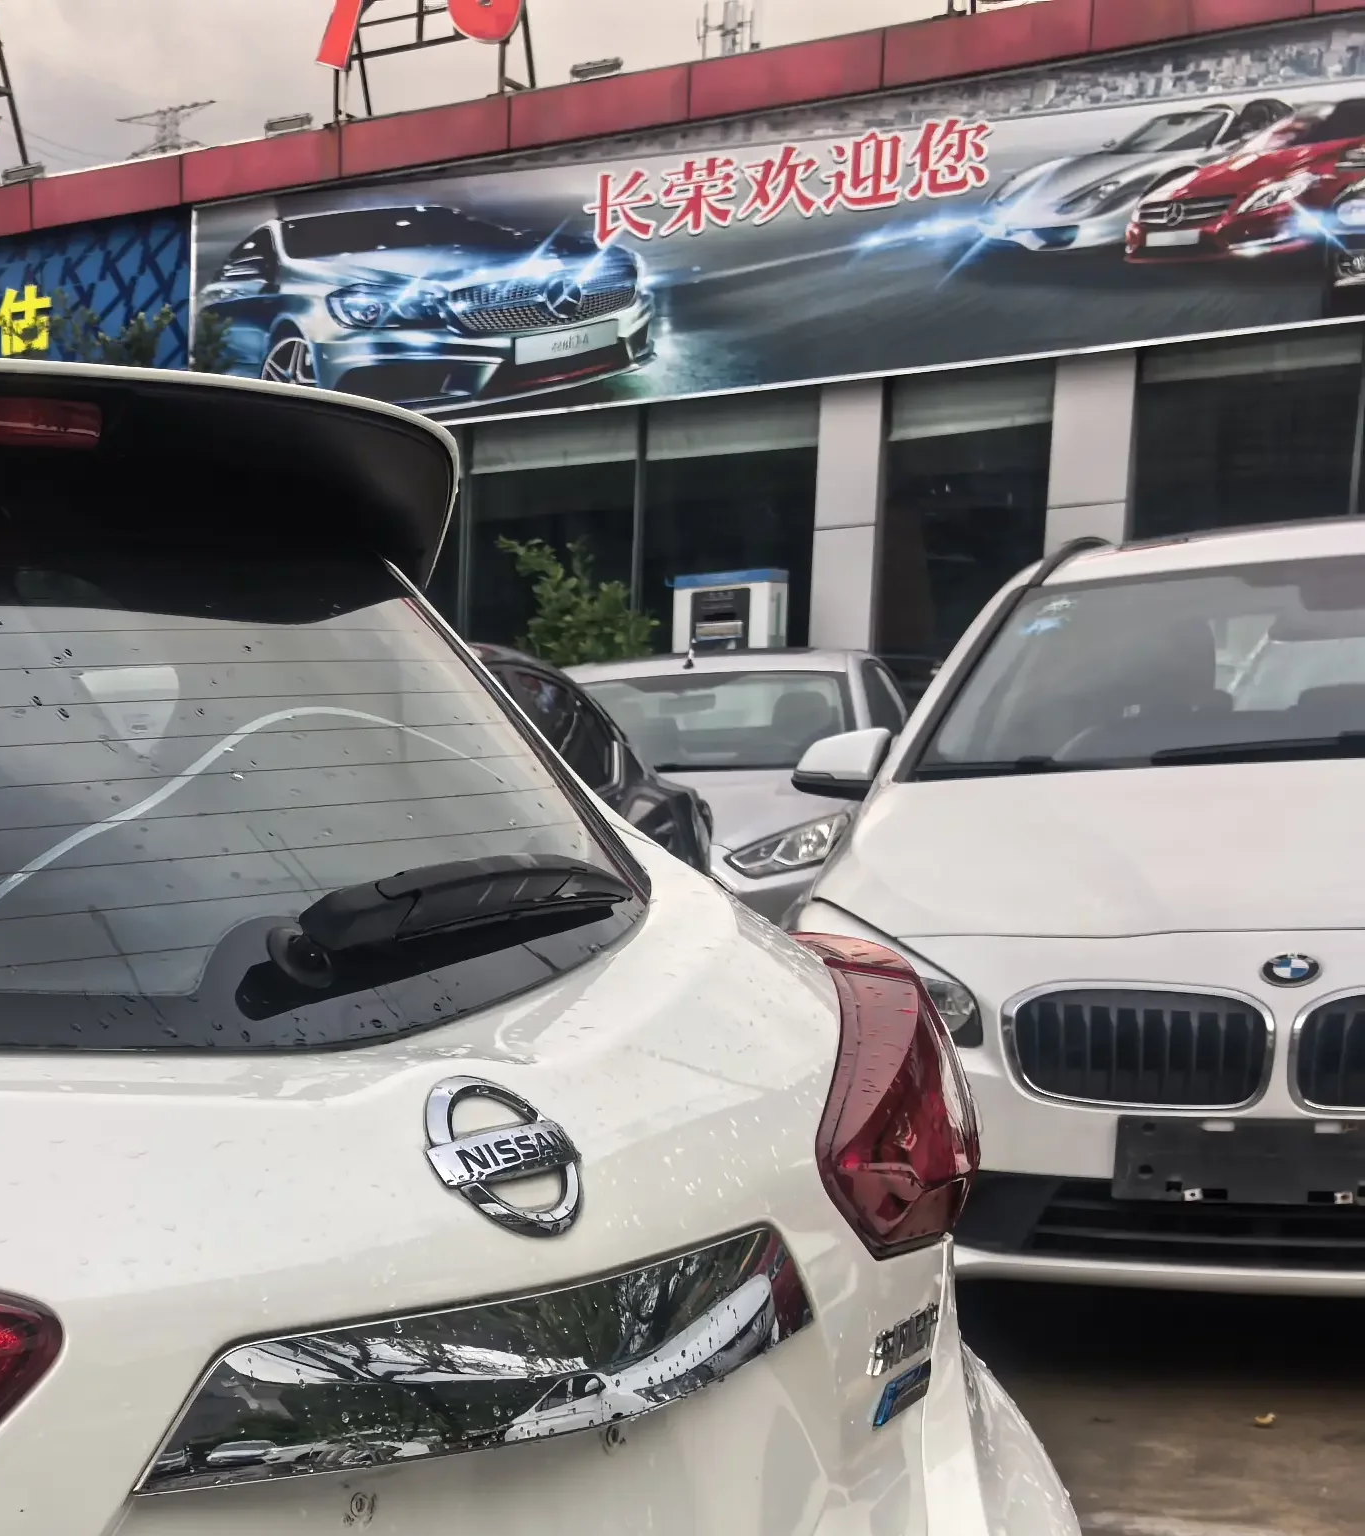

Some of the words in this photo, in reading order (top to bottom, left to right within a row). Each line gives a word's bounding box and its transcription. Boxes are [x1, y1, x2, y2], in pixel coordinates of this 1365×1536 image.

[587, 118, 989, 243] 长荣欢迎您
[455, 1128, 571, 1174] NISSAN
